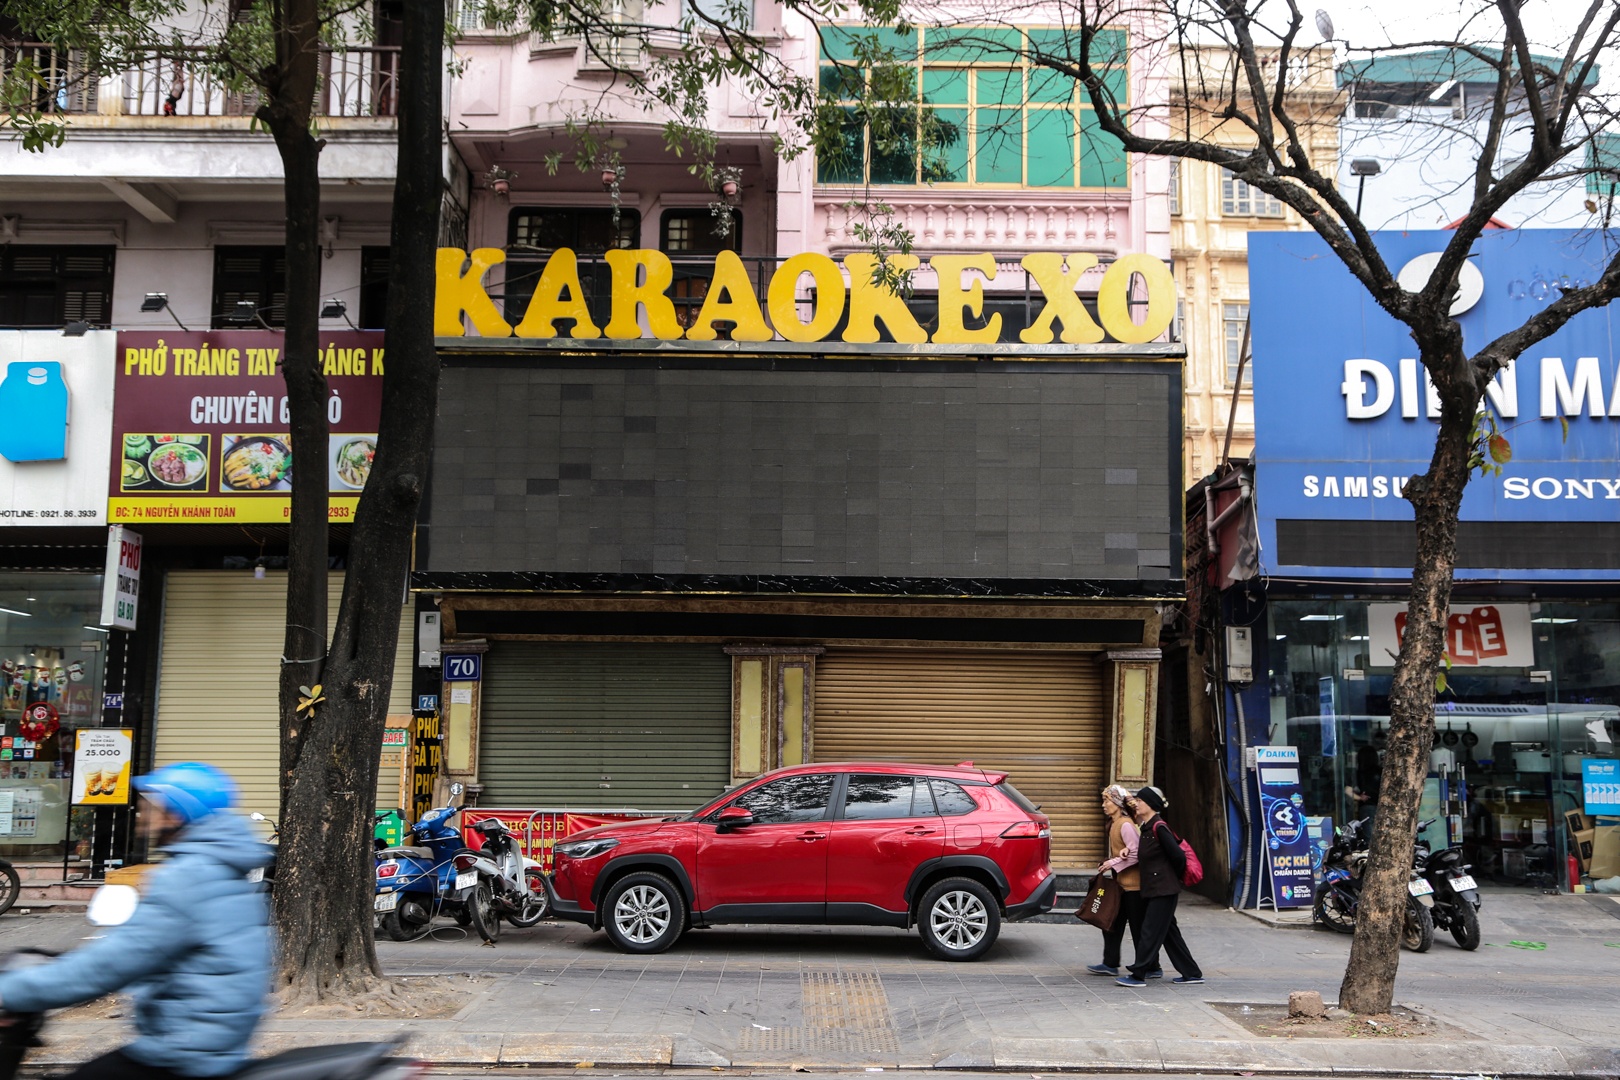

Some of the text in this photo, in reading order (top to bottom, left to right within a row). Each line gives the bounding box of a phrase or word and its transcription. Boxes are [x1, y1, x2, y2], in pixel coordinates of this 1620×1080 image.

[434, 247, 1176, 344] KARAOKE XO
[125, 339, 168, 376] PHỞ
[172, 342, 240, 376] TRÁNG
[245, 348, 280, 376] TAY
[318, 342, 366, 376] ÁNG
[190, 389, 342, 424] CHUYÊN G Ò
[1304, 475, 1409, 498] SAMSU
[1503, 477, 1620, 500] SONY
[115, 506, 130, 518] ĐC:
[132, 507, 142, 518] 74
[145, 503, 179, 518] NGUYỄN
[182, 505, 211, 518] KHÁNH
[328, 506, 349, 518] 2933
[120, 537, 140, 571] PHỞ
[118, 598, 134, 621] GÀ BÒ
[450, 658, 475, 676] 70
[421, 697, 435, 707] 74
[417, 711, 439, 739] PHỞ
[383, 732, 404, 743] CAFE
[415, 742, 427, 767] GÀ
[1266, 750, 1296, 758] DAIKIN
[1273, 852, 1310, 869] LỌC KHÍ
